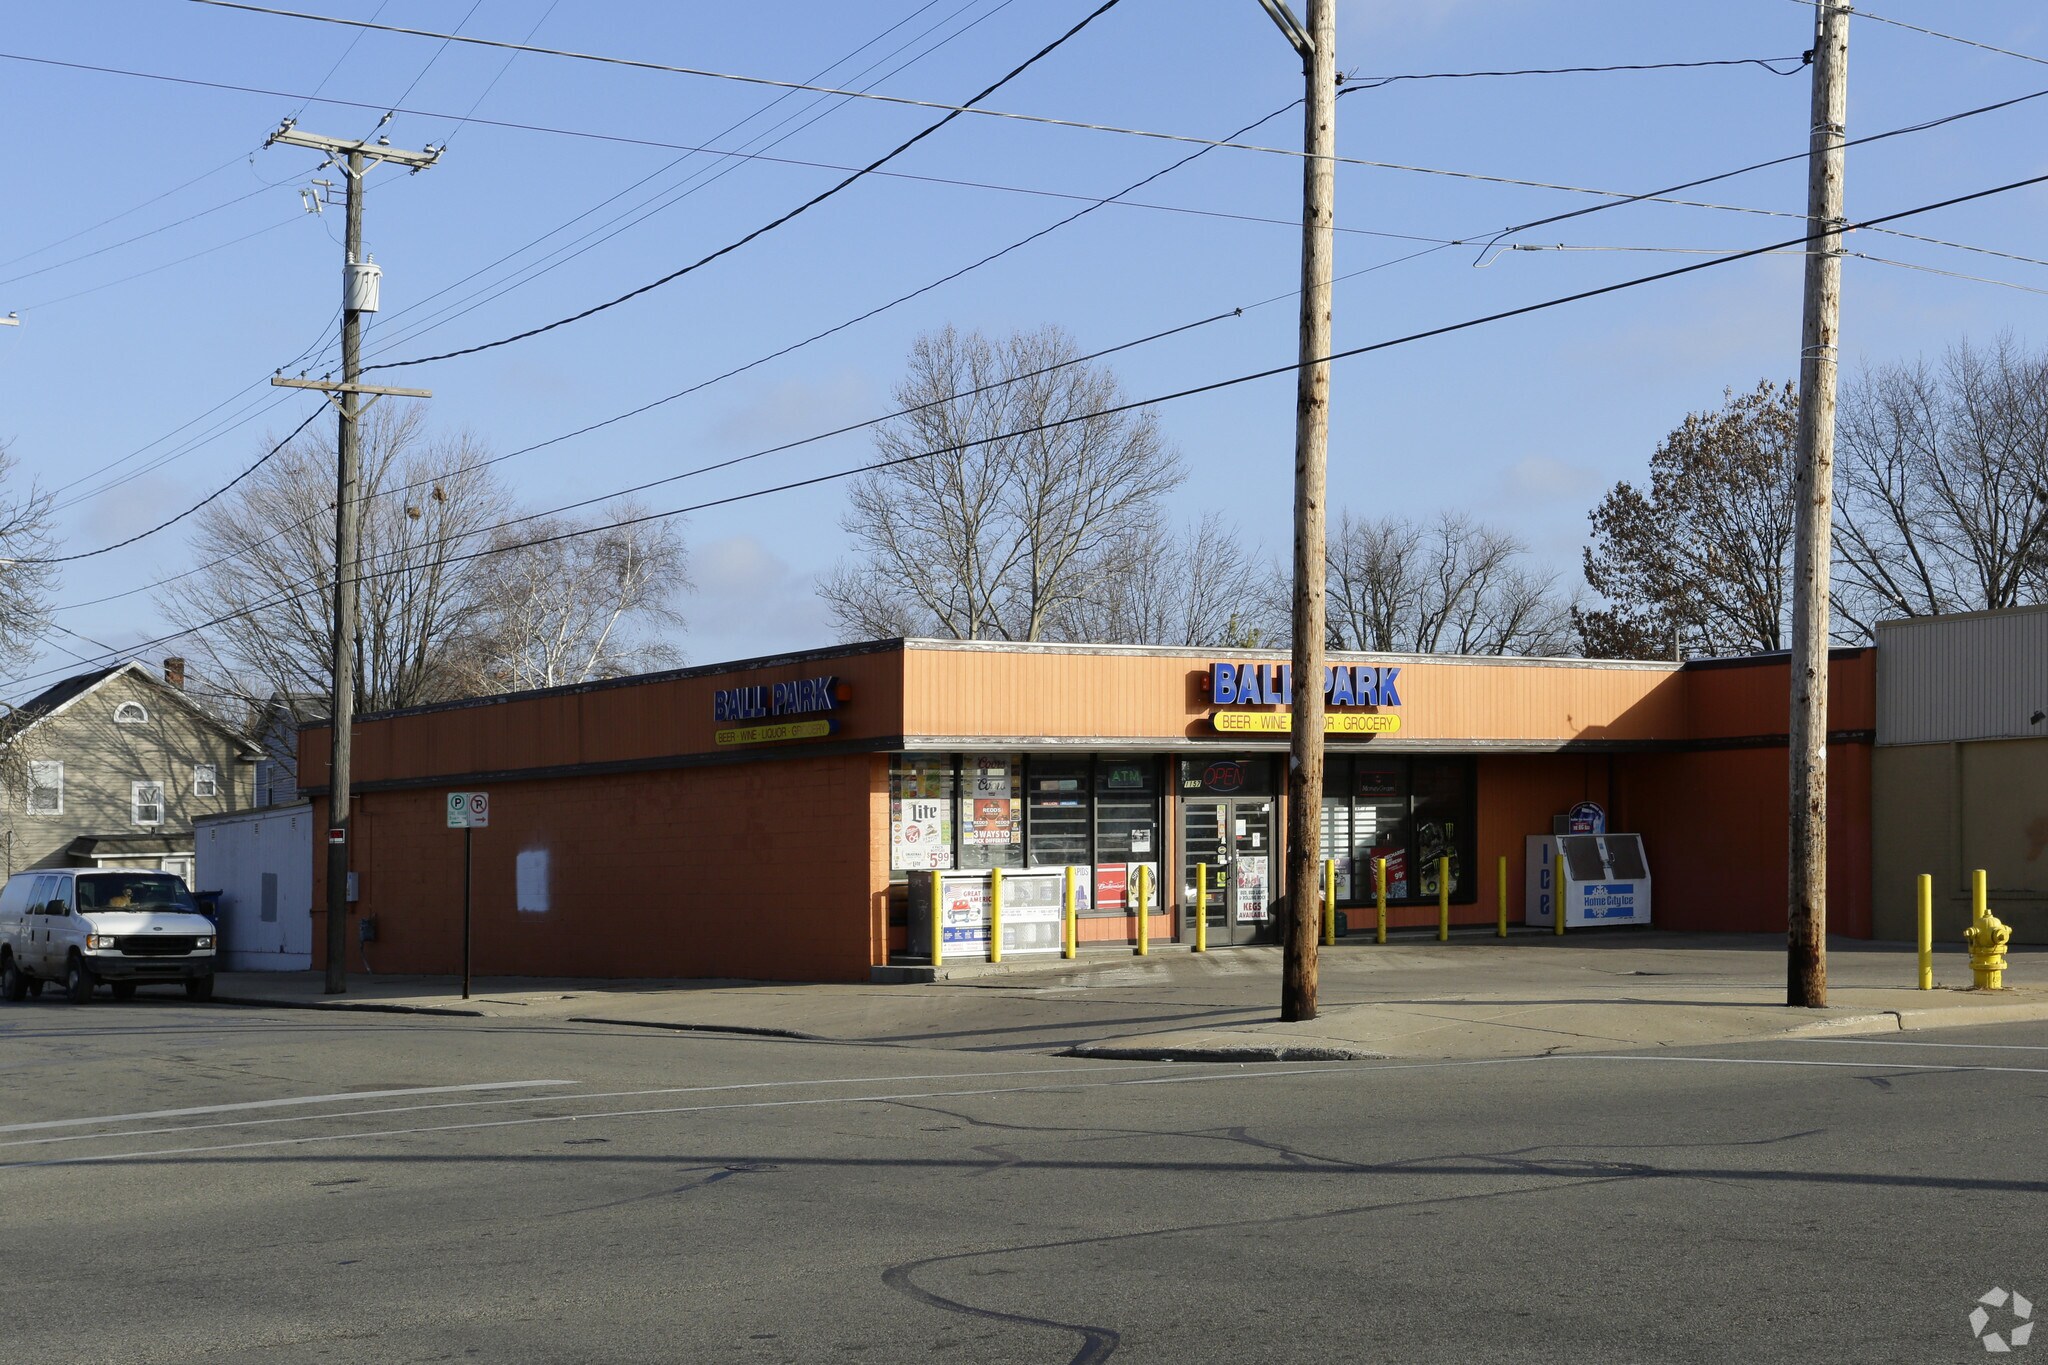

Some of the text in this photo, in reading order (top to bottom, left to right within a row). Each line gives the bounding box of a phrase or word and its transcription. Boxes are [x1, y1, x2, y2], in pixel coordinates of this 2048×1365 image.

[713, 676, 832, 721] BALL PARK
[1222, 714, 1251, 729] BEER
[1261, 715, 1287, 730] WINE
[1344, 716, 1394, 731] GROCERY
[718, 731, 736, 743] BEER
[741, 730, 757, 741] WINE
[762, 727, 787, 739] LIQUOR
[1111, 770, 1140, 782] ATM
[1203, 767, 1247, 785] OPEN
[912, 804, 937, 823] Lite
[973, 830, 1010, 838] 3 WAYS TO
[1075, 867, 1089, 876] PIDS
[1243, 902, 1262, 911] KEGS
[1584, 895, 1634, 907] Home City Ice
[1238, 911, 1266, 919] AVAILABLE
